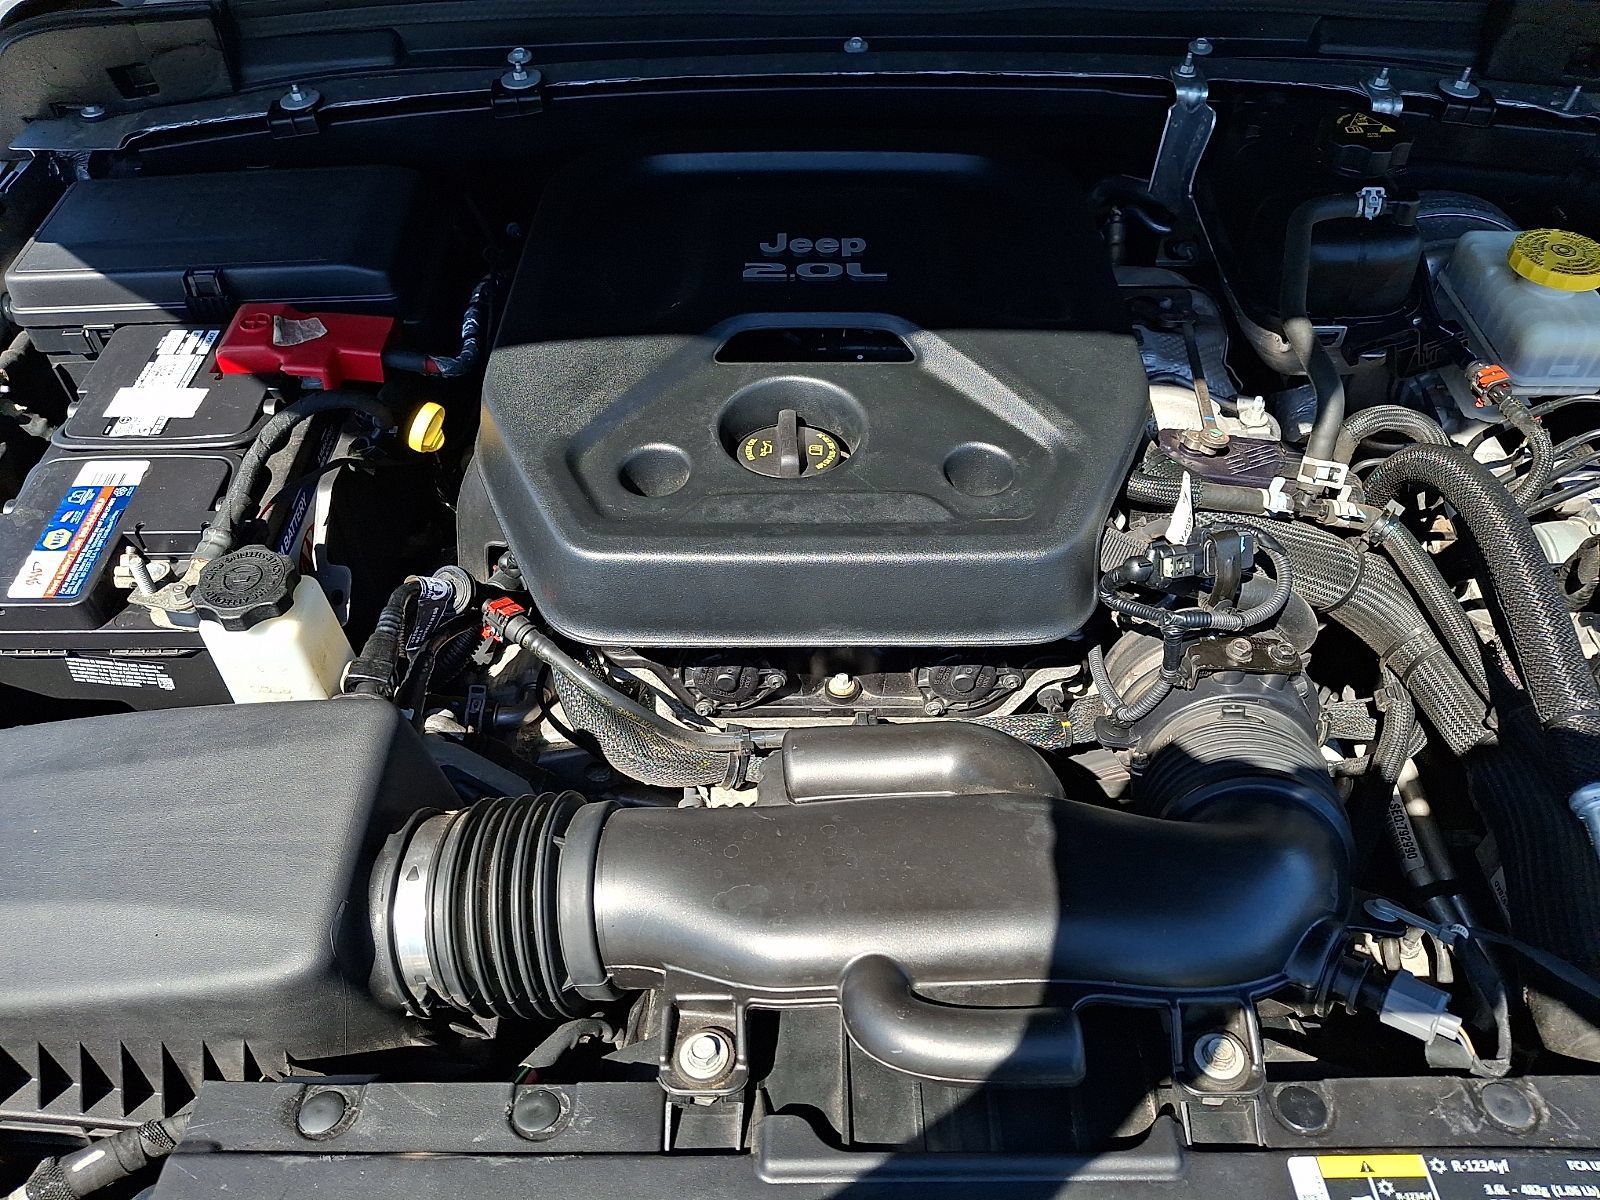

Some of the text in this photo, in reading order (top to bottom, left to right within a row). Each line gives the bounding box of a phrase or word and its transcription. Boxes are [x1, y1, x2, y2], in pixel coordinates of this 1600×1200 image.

[759, 232, 867, 257] Jeep
[742, 262, 888, 281] 2.0L
[282, 492, 308, 552] BATTERY
[1566, 1160, 1592, 1172] FCA
